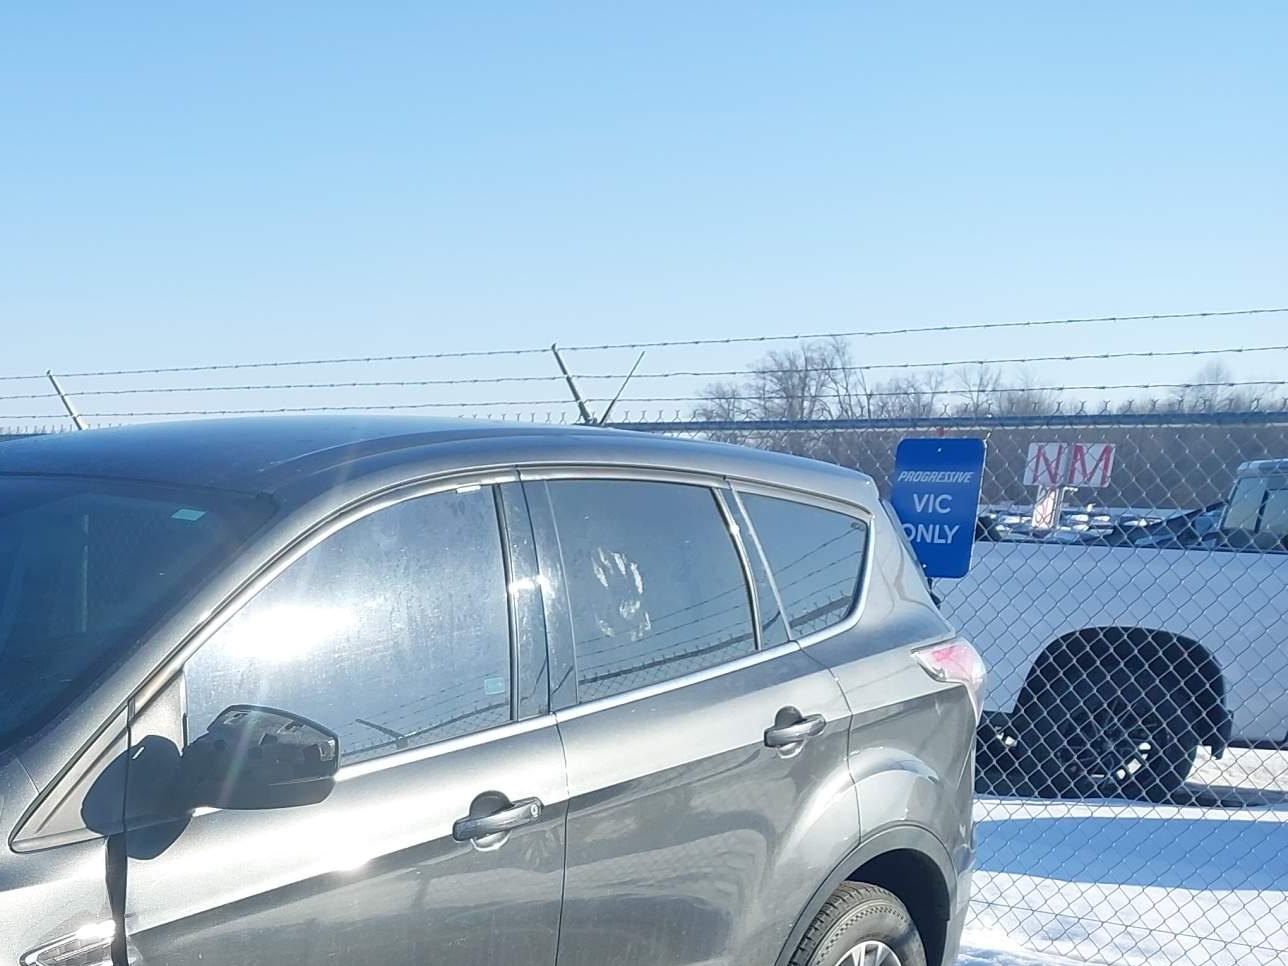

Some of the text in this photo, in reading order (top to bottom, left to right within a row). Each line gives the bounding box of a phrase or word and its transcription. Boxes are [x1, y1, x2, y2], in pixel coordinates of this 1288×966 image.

[898, 471, 974, 483] PROGRESSIVE
[913, 494, 952, 513] VIC
[902, 523, 959, 544] ONLY
